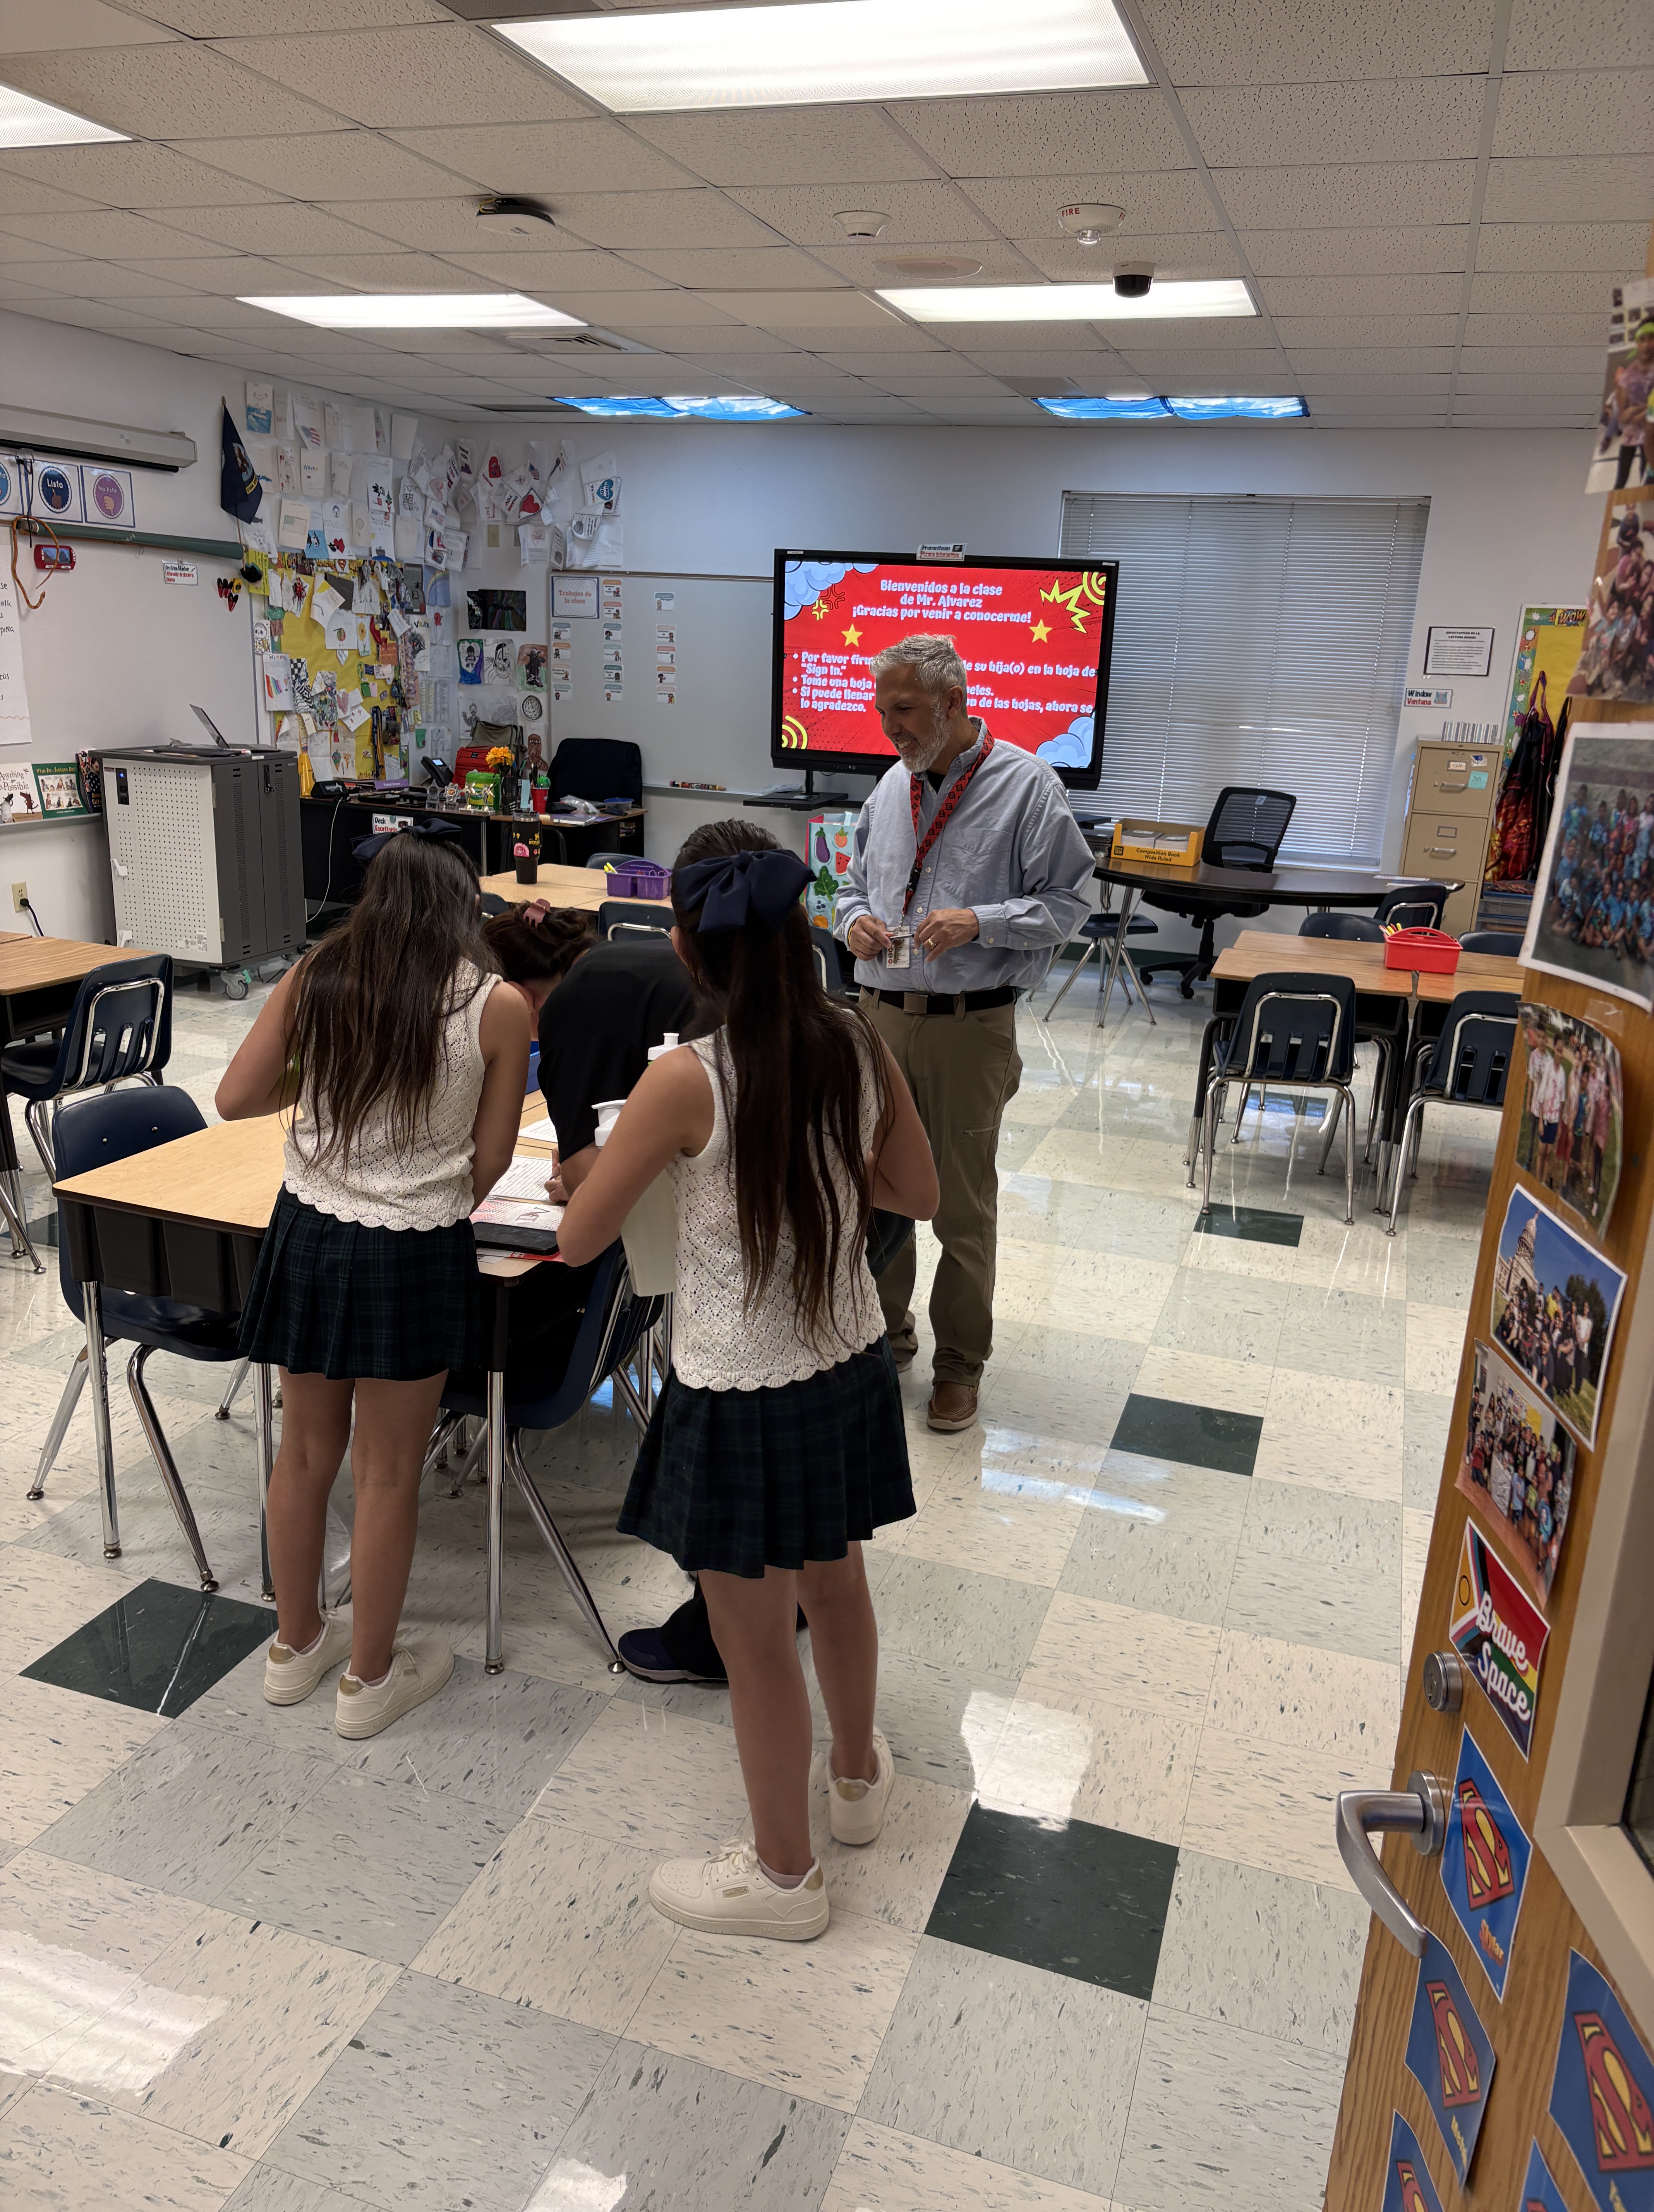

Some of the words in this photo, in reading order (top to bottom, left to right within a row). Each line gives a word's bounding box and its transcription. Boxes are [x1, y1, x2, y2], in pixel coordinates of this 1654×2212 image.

[1062, 208, 1080, 217] FIRE
[508, 496, 518, 512] THANK
[880, 579, 948, 594] Bienvenidos
[950, 585, 957, 594] a
[959, 582, 970, 594] la
[972, 583, 1002, 595] clase
[900, 593, 914, 605] de
[916, 594, 935, 606] Mr.
[938, 595, 982, 608] Alvarez
[853, 604, 898, 617] ¡Gracias
[901, 608, 918, 620] por
[922, 608, 952, 620] venir
[954, 611, 962, 620] a
[963, 609, 1031, 623] conocerme!
[801, 651, 820, 662] Por
[821, 653, 849, 664] favor
[974, 663, 987, 672] su
[988, 661, 1025, 675] hija(o)
[1027, 665, 1041, 674] en
[1043, 664, 1053, 675] la
[1056, 665, 1079, 678] hoja
[1081, 666, 1096, 677] de
[801, 663, 828, 677] "Sign
[801, 674, 827, 686] Tome
[829, 678, 848, 688] una
[850, 677, 872, 690] hoja
[800, 686, 811, 697] Si
[812, 689, 842, 700] puede
[844, 689, 875, 701] llenar
[979, 697, 992, 708] de
[994, 697, 1009, 709] las
[1012, 698, 1044, 713] hojas,
[1045, 701, 1078, 713] ahora
[1080, 704, 1093, 713] se
[800, 698, 810, 708] lo
[812, 700, 866, 712] agradezco.
[3, 781, 29, 792] Possible
[1476, 1591, 1529, 1673] Brave
[1477, 1641, 1530, 1722] Space
[725, 1887, 747, 1897] NAUTICA
